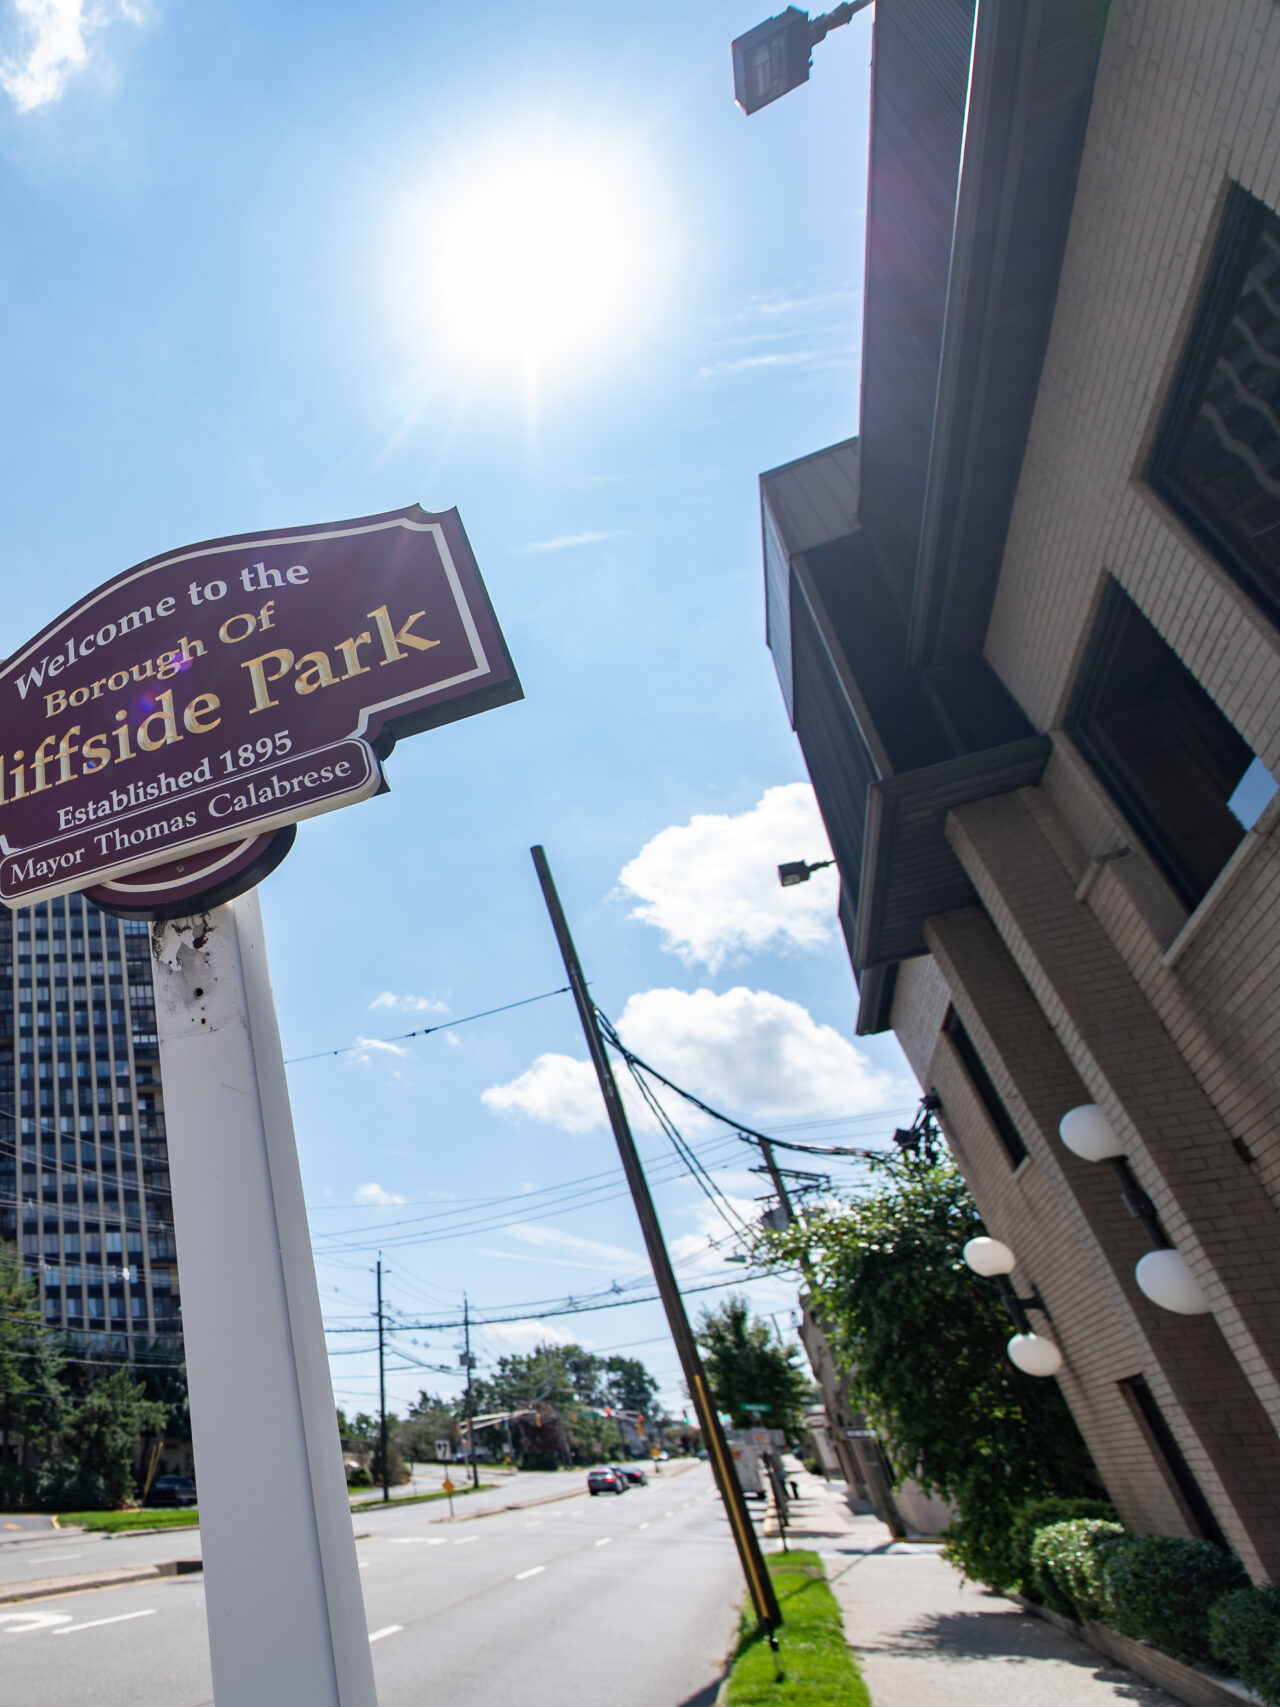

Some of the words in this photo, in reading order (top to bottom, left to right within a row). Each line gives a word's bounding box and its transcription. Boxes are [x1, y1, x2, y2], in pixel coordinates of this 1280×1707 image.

[15, 597, 176, 700] Welcome
[188, 579, 228, 606] to
[240, 561, 310, 592] the
[44, 637, 207, 718] Borough
[219, 601, 276, 645] Of
[241, 604, 441, 715] Park
[10, 847, 85, 885] Mayor
[94, 811, 197, 856] Thomas
[207, 761, 352, 818] Calabrese
[57, 757, 213, 831] Established
[219, 729, 292, 775] 1895
